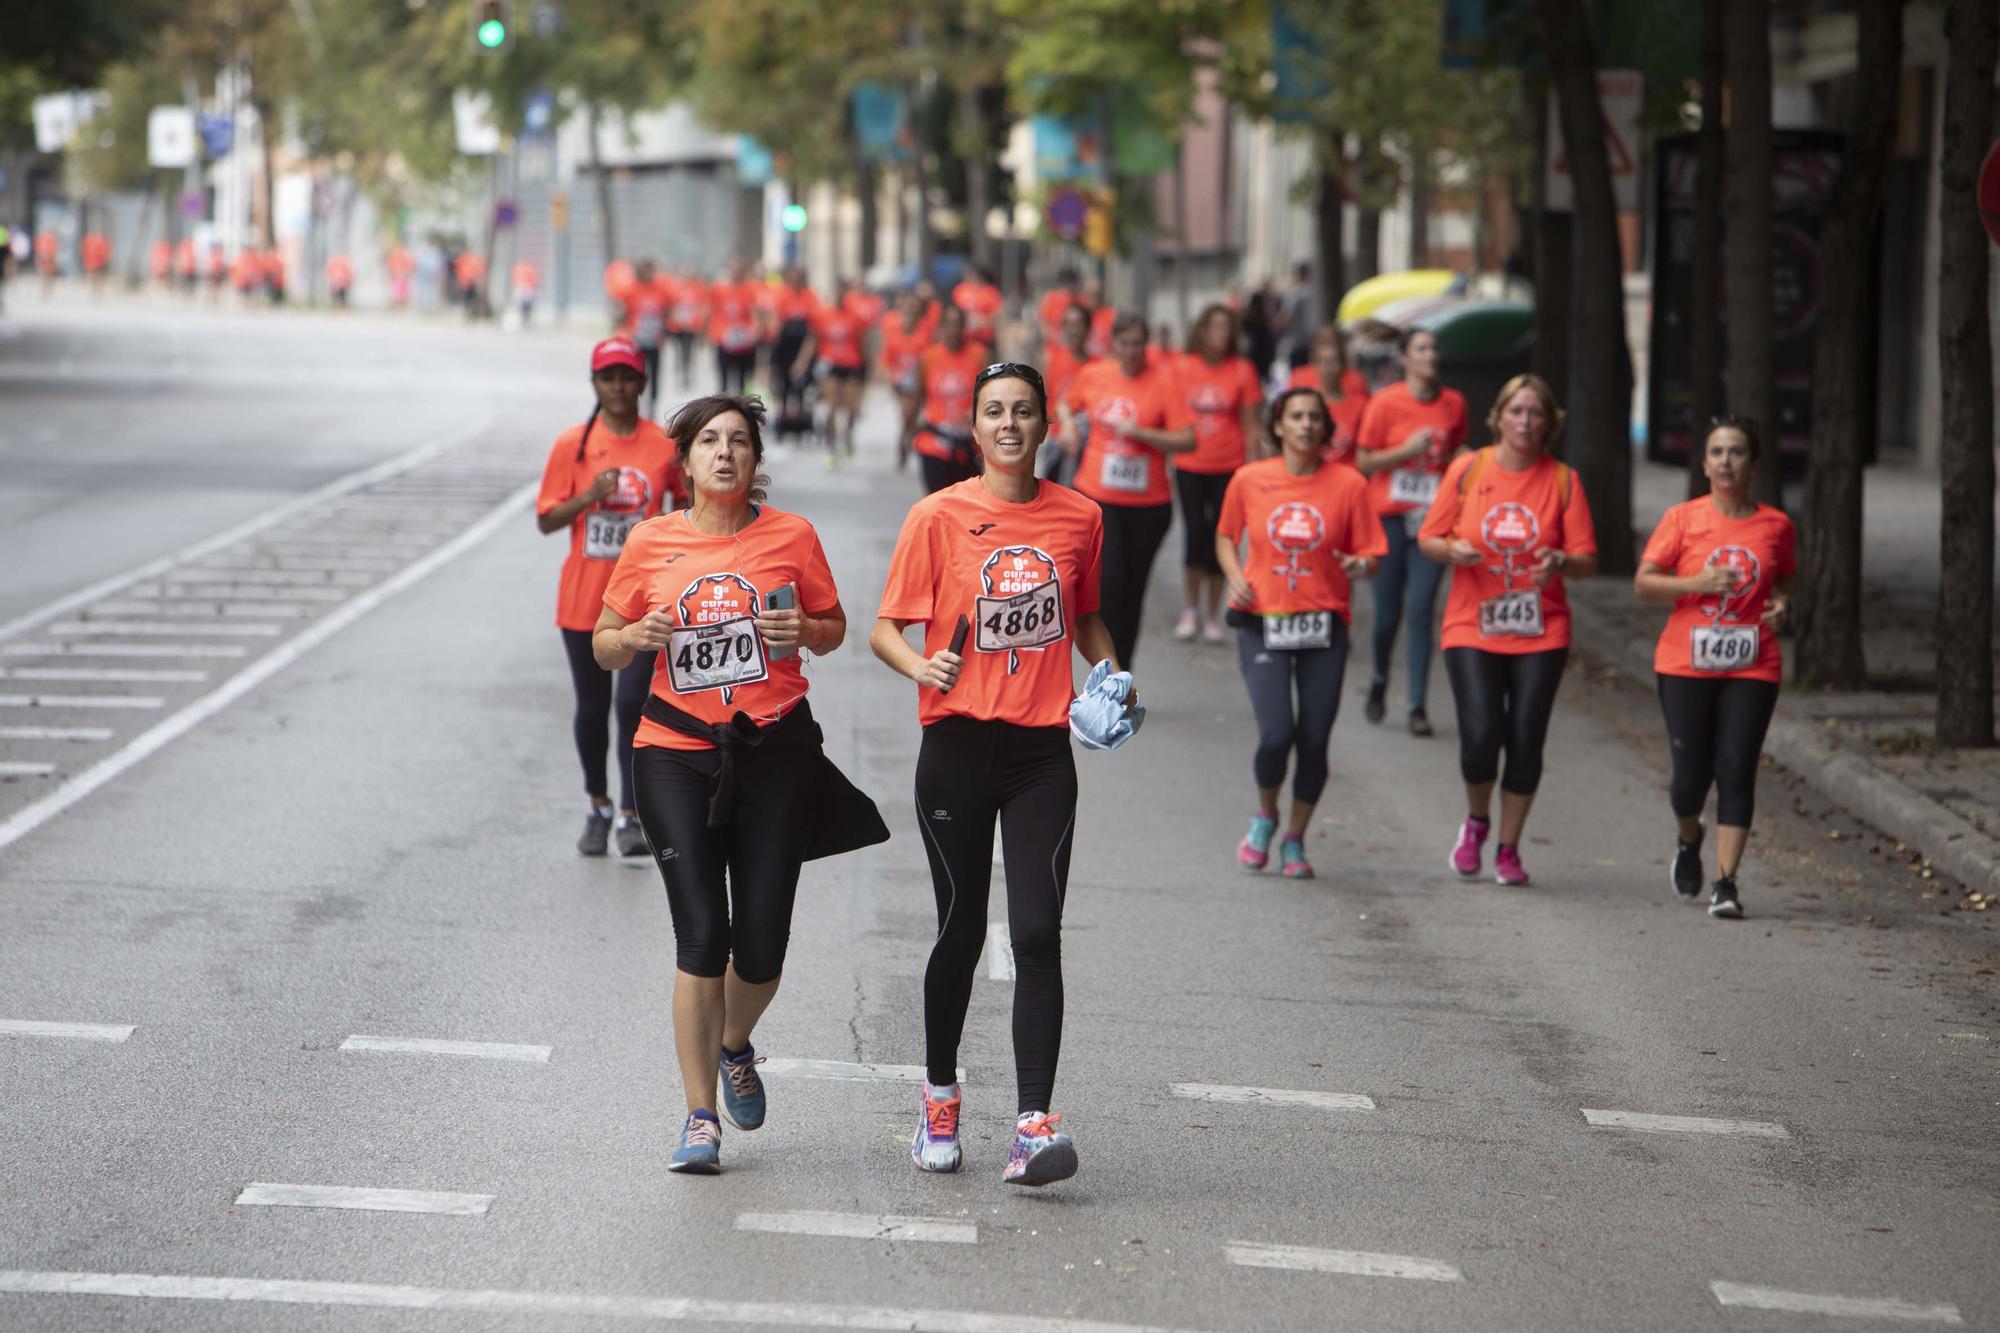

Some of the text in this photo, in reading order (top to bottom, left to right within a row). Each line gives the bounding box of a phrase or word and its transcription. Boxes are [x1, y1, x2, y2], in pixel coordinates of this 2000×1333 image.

[590, 523, 629, 546] 388
[1003, 570, 1039, 579] cursa
[701, 600, 739, 608] cursa
[1484, 601, 1535, 626] 3445
[984, 596, 1056, 636] 4868
[675, 633, 753, 674] 4870
[1699, 637, 1752, 659] 1480
